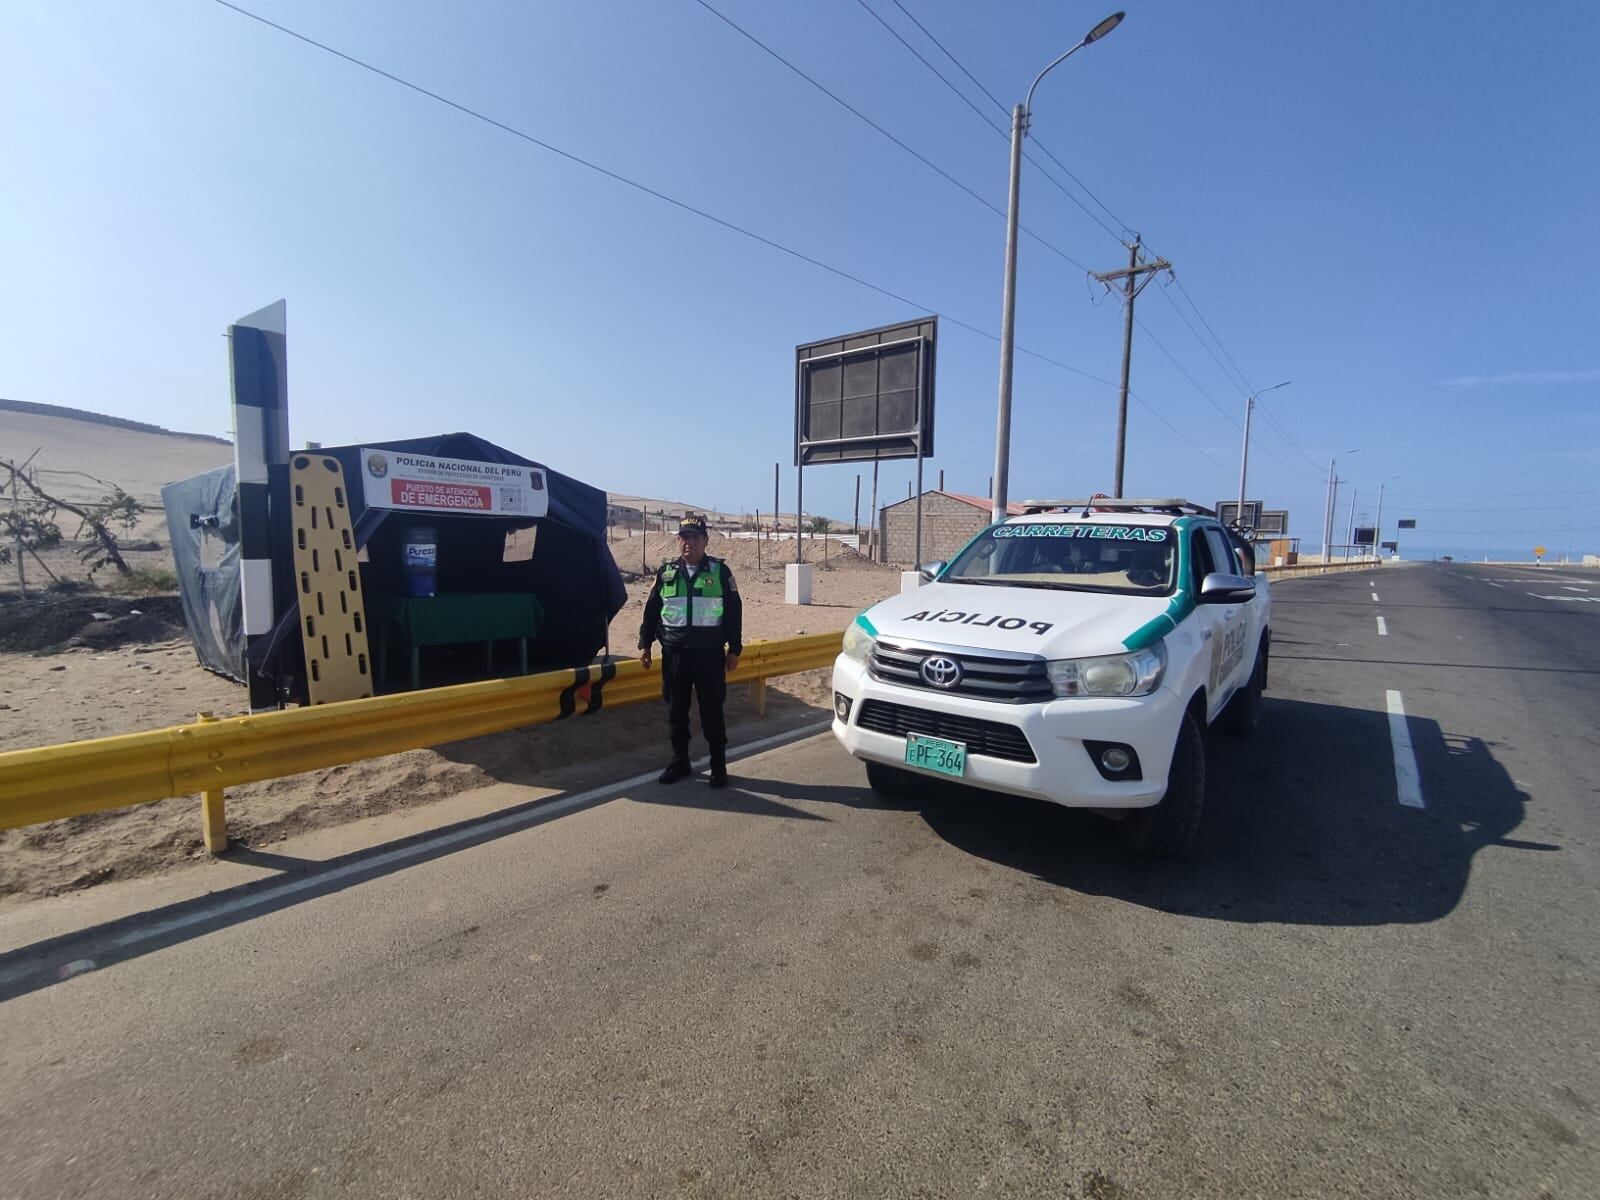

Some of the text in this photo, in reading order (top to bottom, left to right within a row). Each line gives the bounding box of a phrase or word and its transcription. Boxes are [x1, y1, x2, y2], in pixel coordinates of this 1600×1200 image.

[438, 461, 482, 473] NACIONAL
[484, 466, 499, 475] DEL
[406, 483, 434, 493] PUESTO
[435, 486, 445, 494] DE
[400, 491, 484, 509] DE EMERGENCIA
[992, 524, 1168, 542] CARRETERAS
